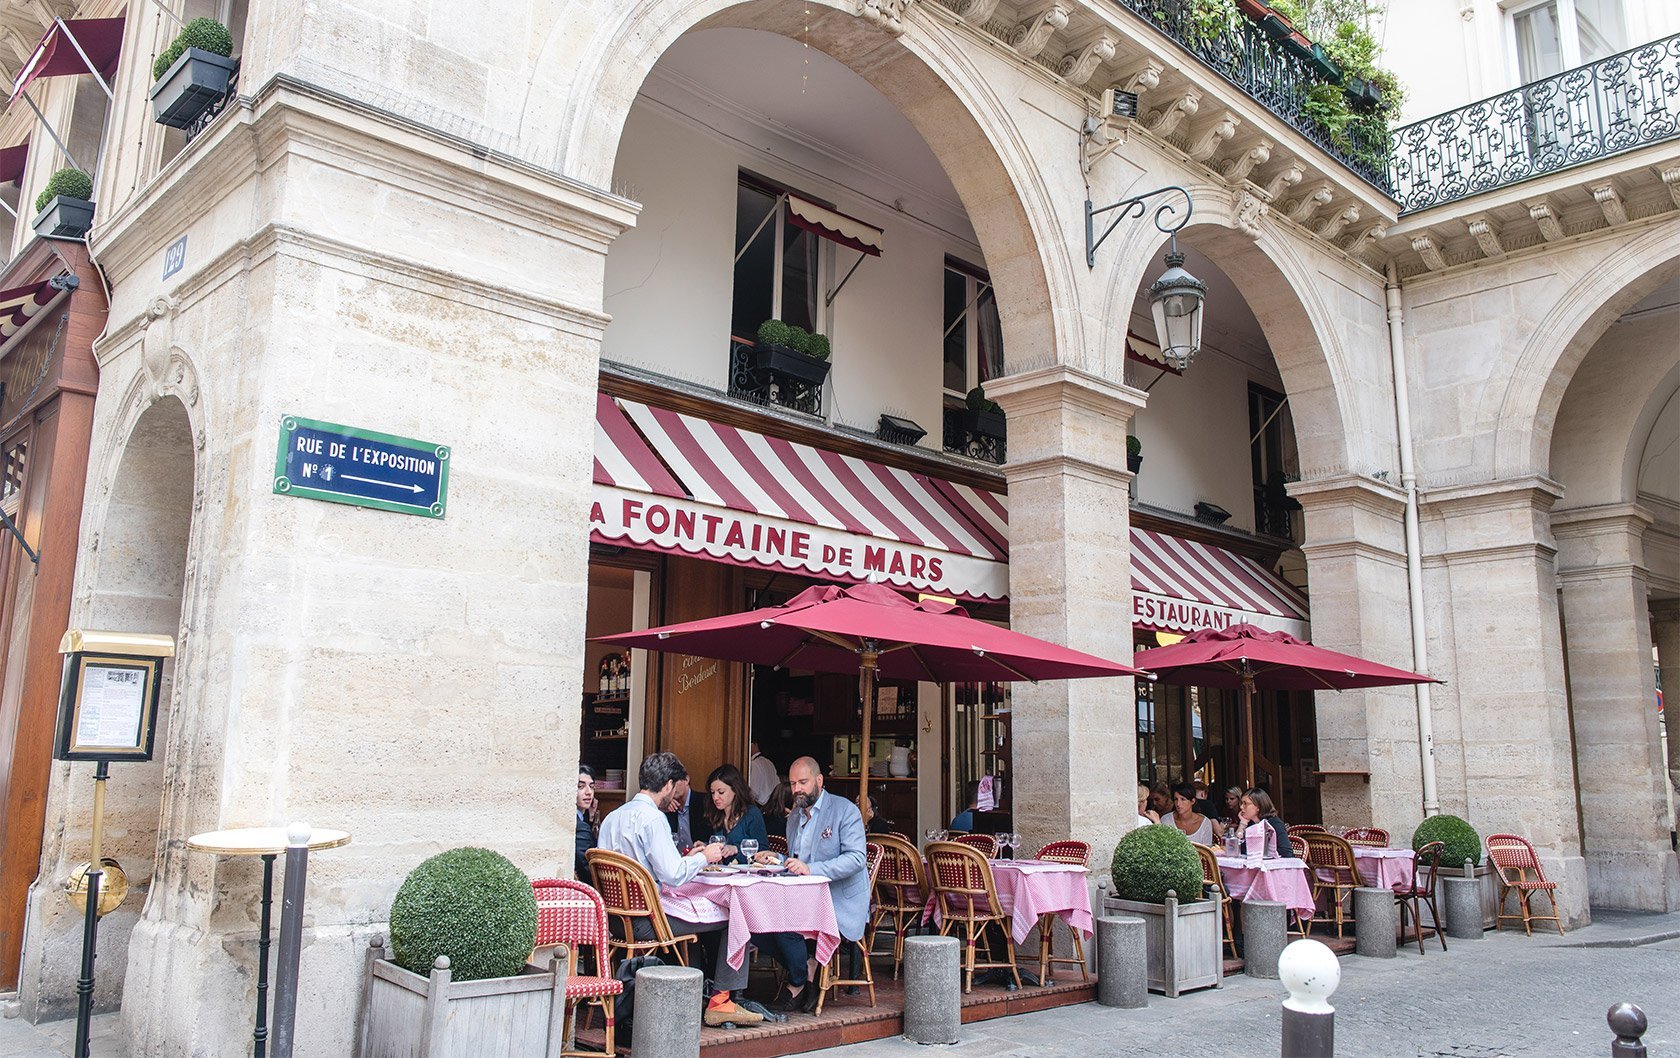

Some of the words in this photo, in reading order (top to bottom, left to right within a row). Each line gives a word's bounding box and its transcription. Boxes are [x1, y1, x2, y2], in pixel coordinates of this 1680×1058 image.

[164, 242, 183, 276] 129
[297, 436, 323, 455] RUE
[330, 443, 347, 459] DE
[352, 446, 435, 475] L'EXPOSITION
[623, 498, 811, 560] FONTAINE
[823, 544, 853, 567] DE
[864, 544, 944, 582] MARS
[1133, 596, 1232, 629] ESTAURANT
